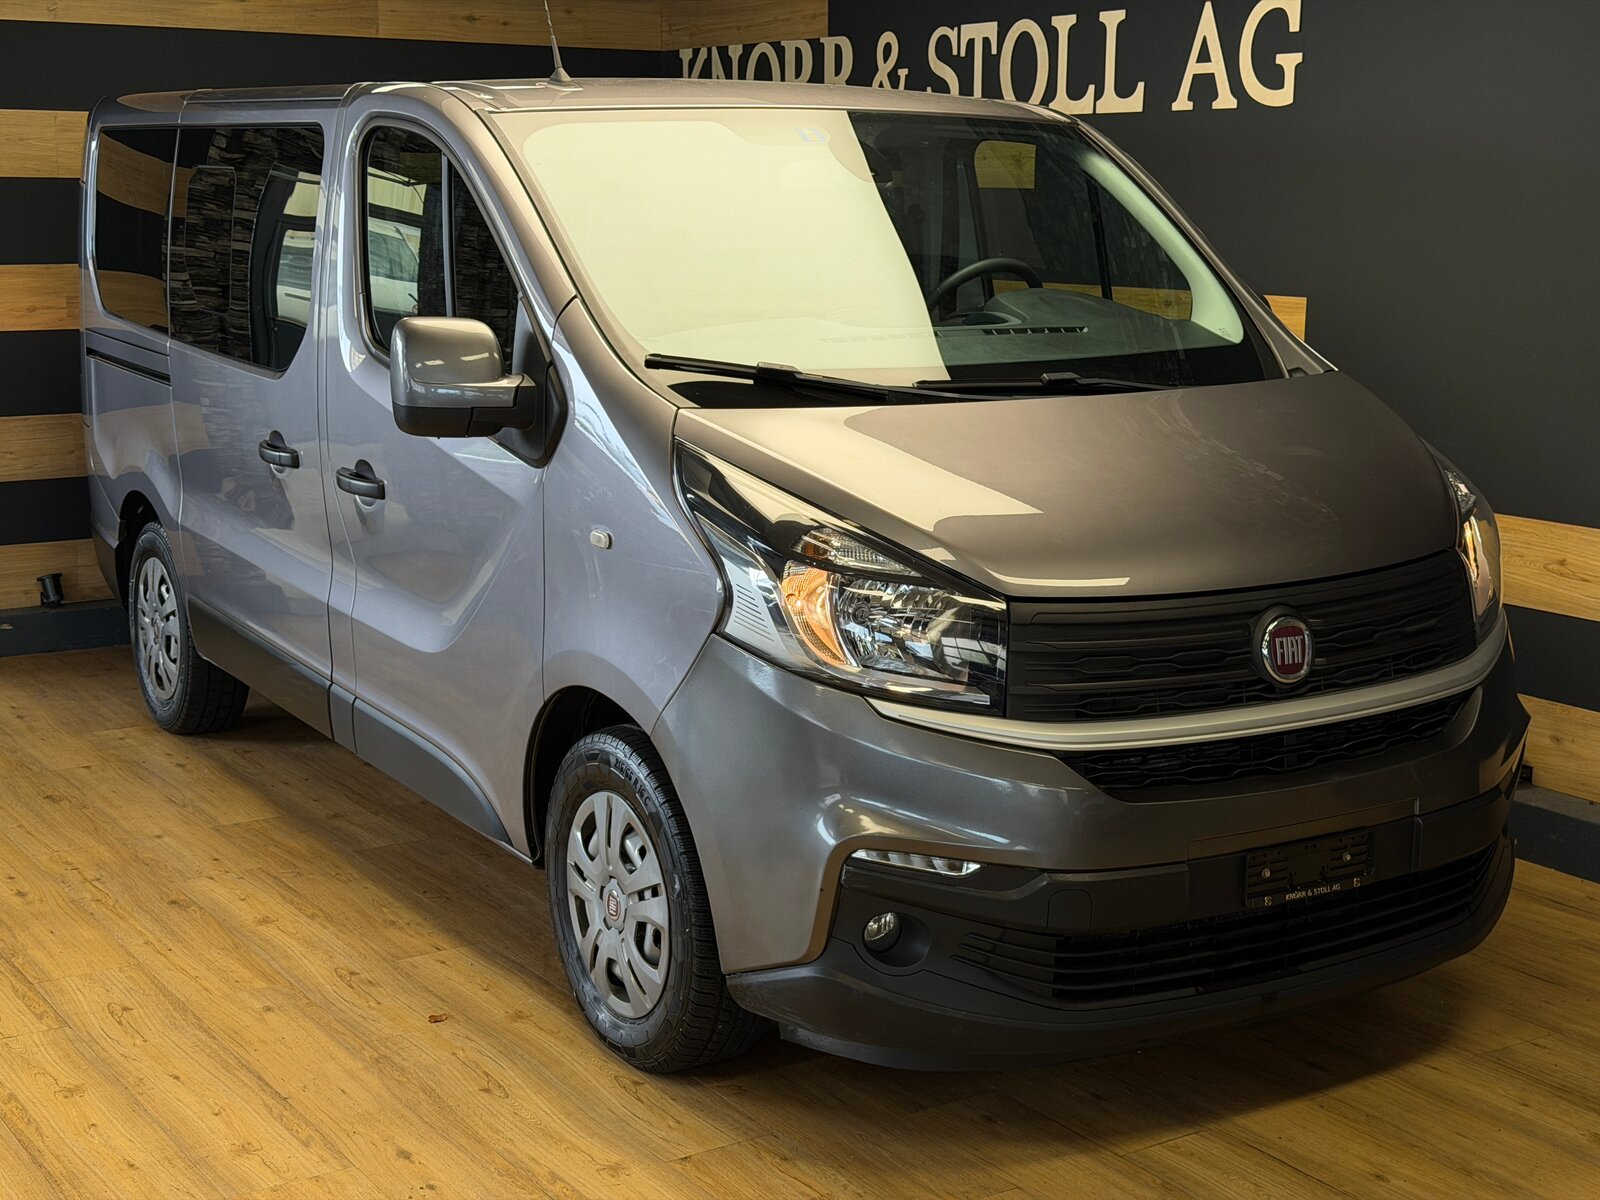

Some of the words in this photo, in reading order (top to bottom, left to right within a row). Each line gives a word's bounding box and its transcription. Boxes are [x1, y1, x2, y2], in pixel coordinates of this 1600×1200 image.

[871, 31, 909, 90] &
[926, 9, 1145, 114] STOLL
[1172, 0, 1303, 110] AG
[1275, 635, 1303, 666] FIAT
[1314, 885, 1331, 895] STOLL
[1332, 883, 1341, 891] AG
[609, 895, 617, 915] FIAT
